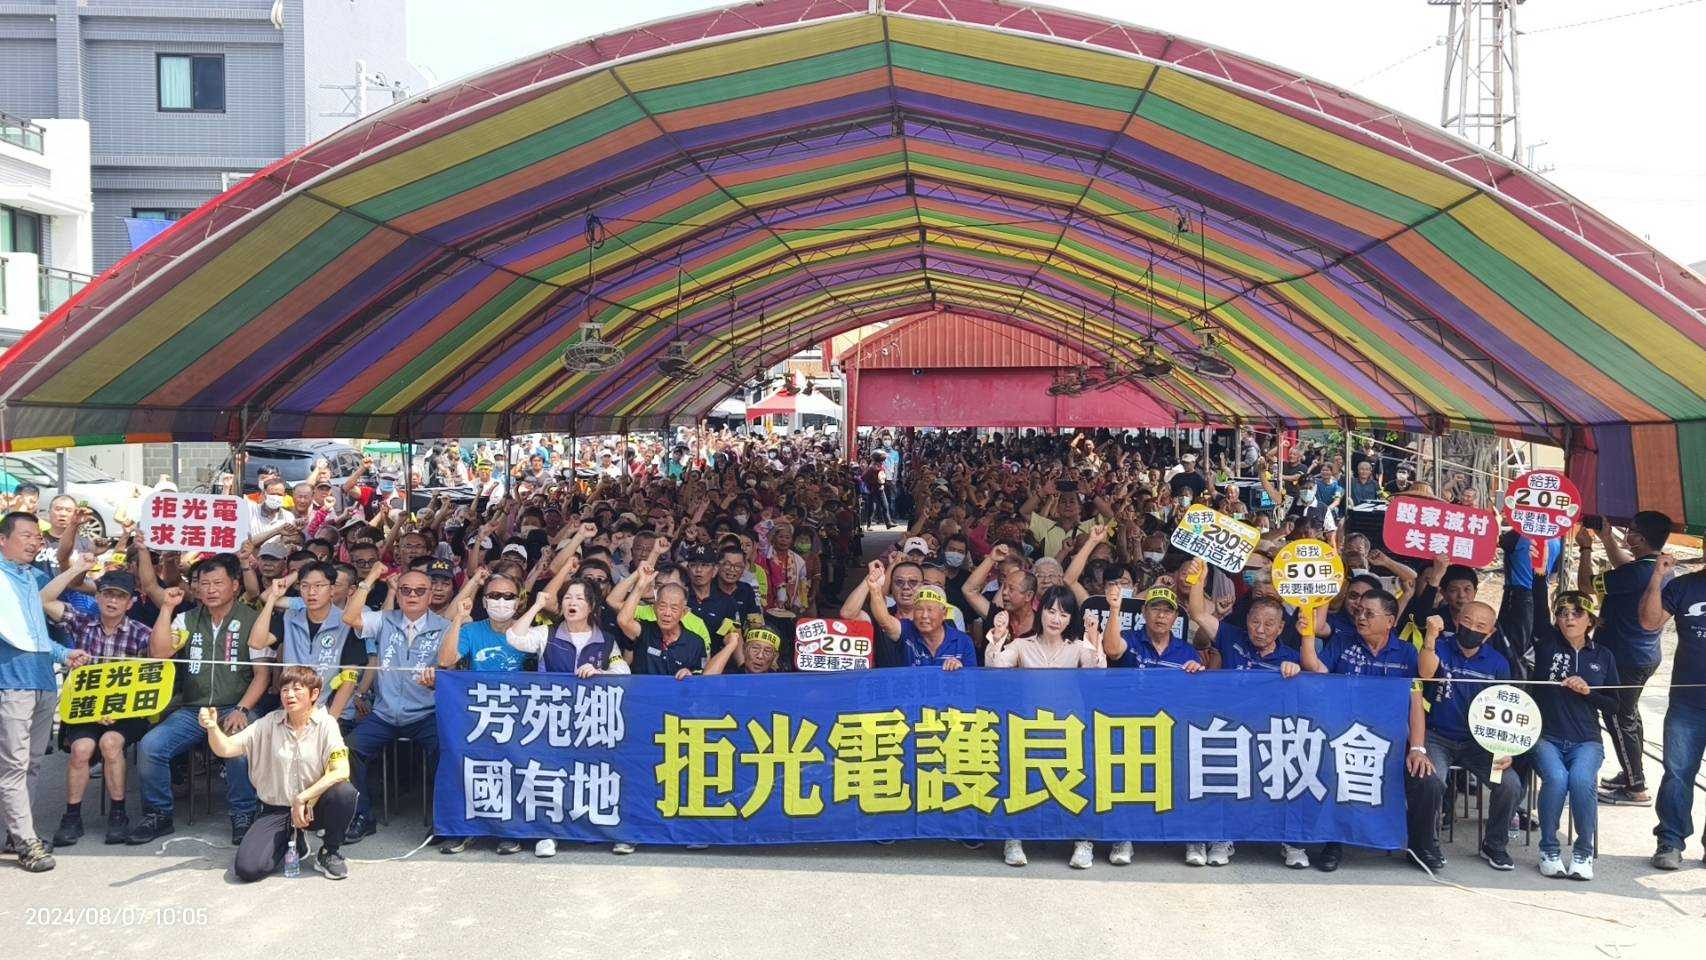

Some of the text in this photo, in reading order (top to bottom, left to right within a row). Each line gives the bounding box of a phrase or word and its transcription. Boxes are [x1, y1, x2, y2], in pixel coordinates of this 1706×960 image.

[1530, 475, 1558, 489] 給我
[1516, 489, 1570, 509] 20甲
[151, 497, 239, 522] 拒光電
[1187, 511, 1215, 524] 給我
[1395, 503, 1489, 536] 毀家滅村
[1513, 511, 1548, 524] 我要種
[150, 526, 237, 549] 求活路
[1523, 522, 1557, 535] 西洋芹
[1203, 524, 1254, 554] 200甲
[1173, 528, 1245, 571] 種樹造林
[1296, 546, 1320, 557] 給我
[1287, 563, 1332, 578] 50甲
[1279, 583, 1339, 595] 我要種地瓜
[798, 622, 827, 639] 給我
[823, 637, 868, 655] 20甲
[800, 655, 867, 670] 我要種芝麻
[74, 662, 164, 691] 拒光電
[68, 688, 160, 719] 護良田
[1497, 689, 1520, 704] 給我
[466, 683, 625, 749] 芳苑鄉
[1484, 706, 1529, 727] 50甲
[1474, 724, 1532, 747] 我要種水稻
[654, 708, 1391, 819] 拒光電護良田 自救會
[463, 756, 622, 827] 國有地
